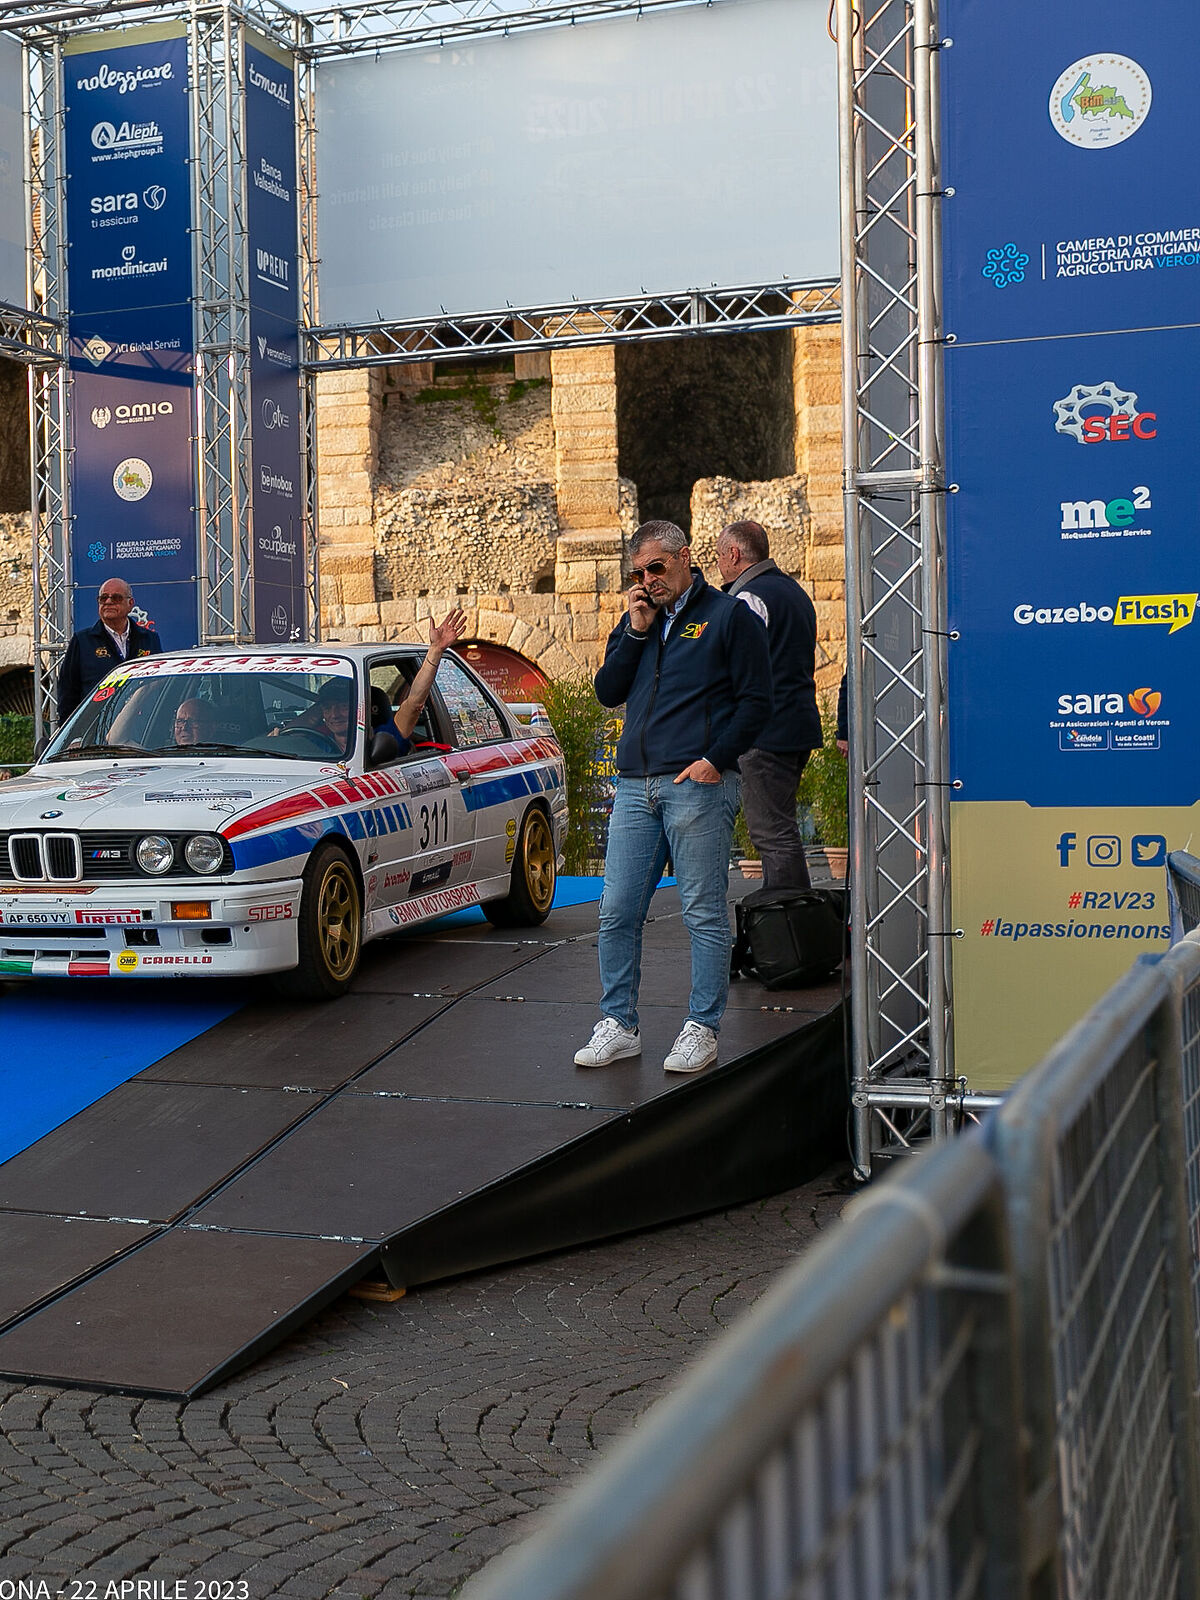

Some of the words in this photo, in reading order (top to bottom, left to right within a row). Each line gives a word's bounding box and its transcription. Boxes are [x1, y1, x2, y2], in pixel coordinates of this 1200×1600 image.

[77, 62, 172, 94] noleggiare
[115, 121, 158, 142] Aleph
[91, 145, 163, 163] www.alephgroup.it
[261, 158, 282, 181] Banca
[253, 171, 290, 201] Valsabbina
[90, 192, 138, 214] sara
[91, 219, 99, 228] ti
[100, 214, 139, 227] assicura
[1056, 237, 1116, 253] CAMERA
[1118, 235, 1133, 247] DI
[1057, 248, 1131, 265] INDUSTRIA
[91, 257, 168, 279] mondinicavi
[1056, 258, 1154, 278] AGRICOLTURA
[115, 343, 128, 354] ACI
[129, 341, 154, 353] Global
[154, 338, 181, 350] Servizi
[115, 401, 174, 418] amia
[1083, 412, 1157, 443] SEC
[1100, 530, 1122, 538] Show
[1123, 528, 1152, 537] Service
[1013, 602, 1114, 625] Gazebo
[1119, 599, 1190, 620] Flash
[121, 656, 341, 674] FRACASSO
[1057, 693, 1124, 715] sara
[1065, 720, 1110, 728] Assicurazioni
[1114, 719, 1137, 728] Agenti
[1115, 734, 1133, 742] Luca
[419, 799, 448, 850] 311
[100, 850, 121, 858] M3
[384, 868, 411, 888] brembo
[394, 900, 423, 923] BMW
[419, 883, 481, 915] MOTORSPORT
[1068, 891, 1156, 910] #R2V23
[9, 913, 24, 924] AP
[27, 913, 48, 923] 650
[52, 913, 68, 924] VY
[75, 909, 141, 924] PIRELLI
[142, 956, 213, 965] CARELLO
